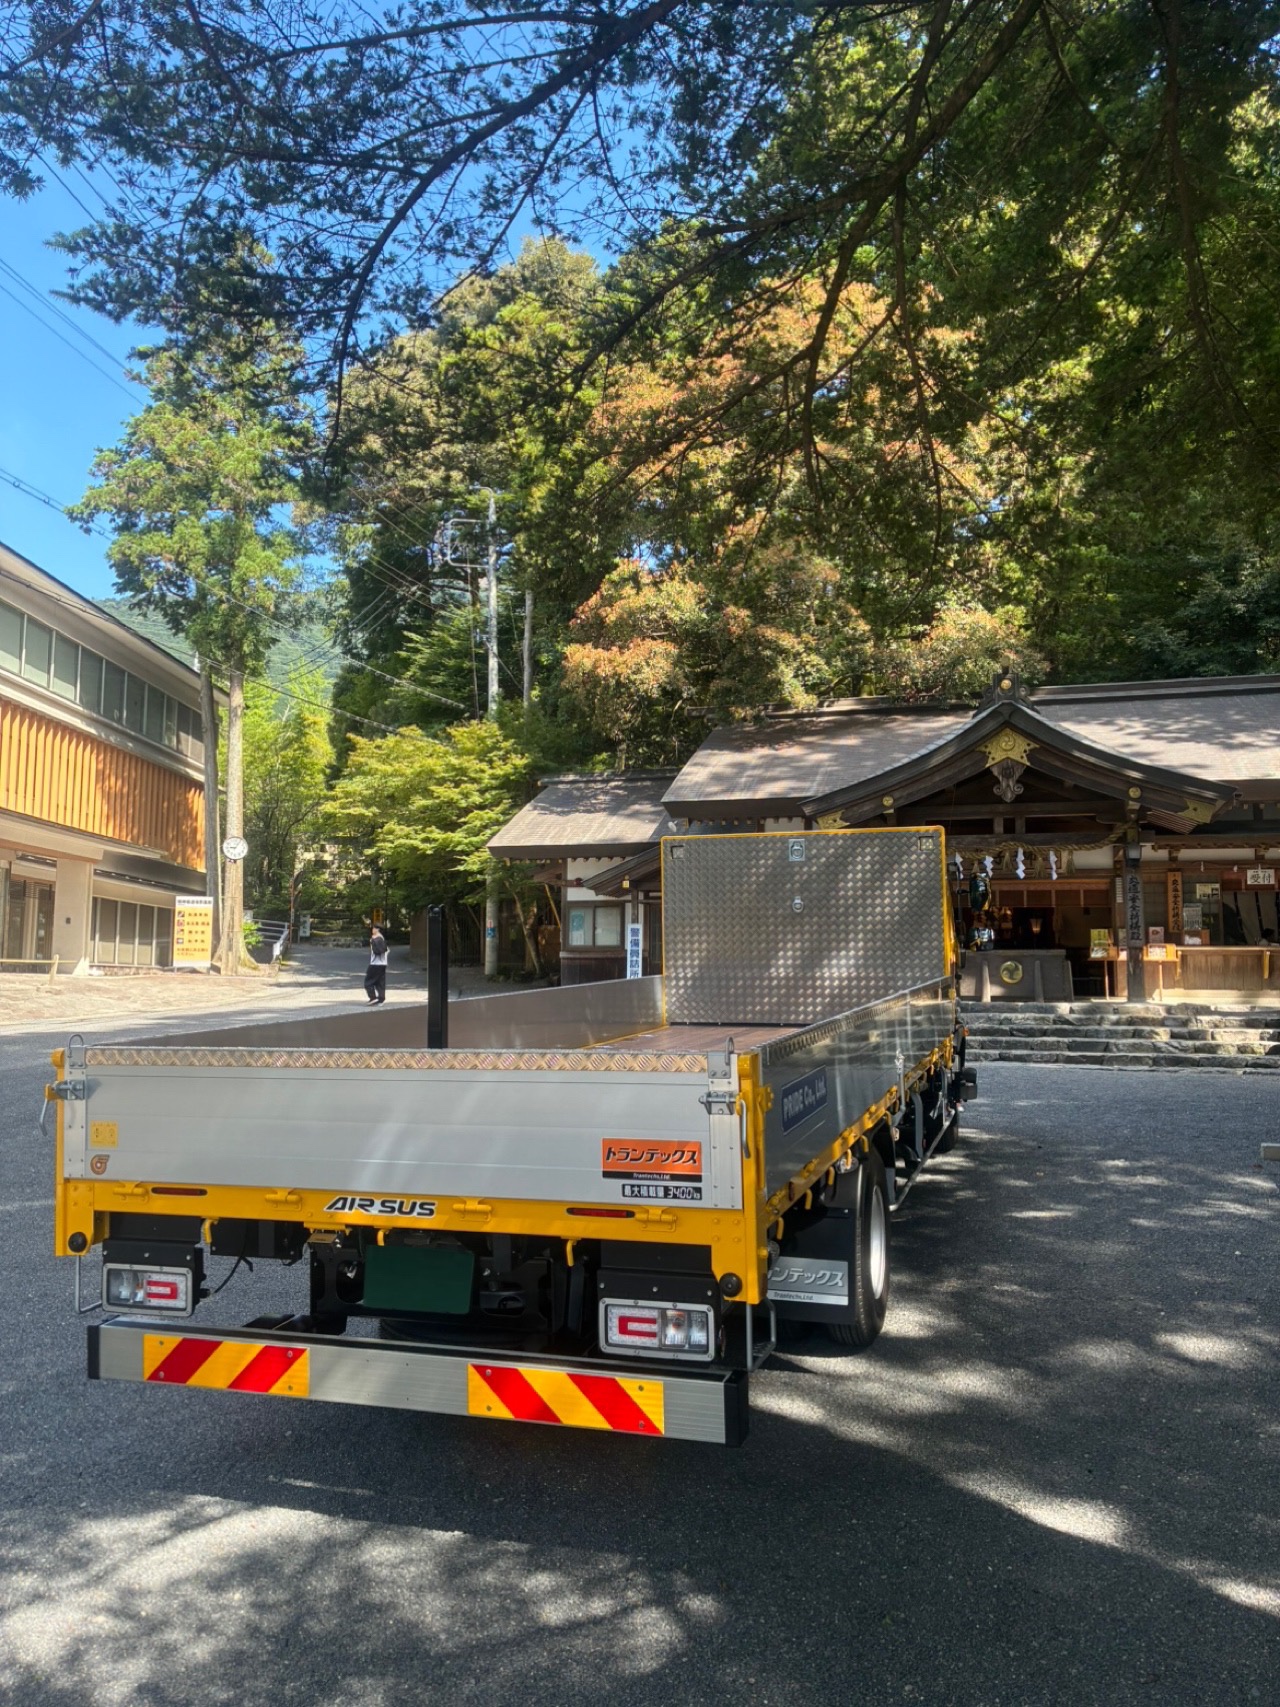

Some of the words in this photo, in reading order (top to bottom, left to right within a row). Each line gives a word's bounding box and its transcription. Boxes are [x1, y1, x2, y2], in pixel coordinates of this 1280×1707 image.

[1250, 873, 1272, 884] 受付
[605, 1147, 698, 1165] トランテックス
[623, 1185, 665, 1198] 最大積載量
[324, 1196, 375, 1213] AIR
[377, 1199, 436, 1217] SUS
[768, 1267, 845, 1288] ンテックス
